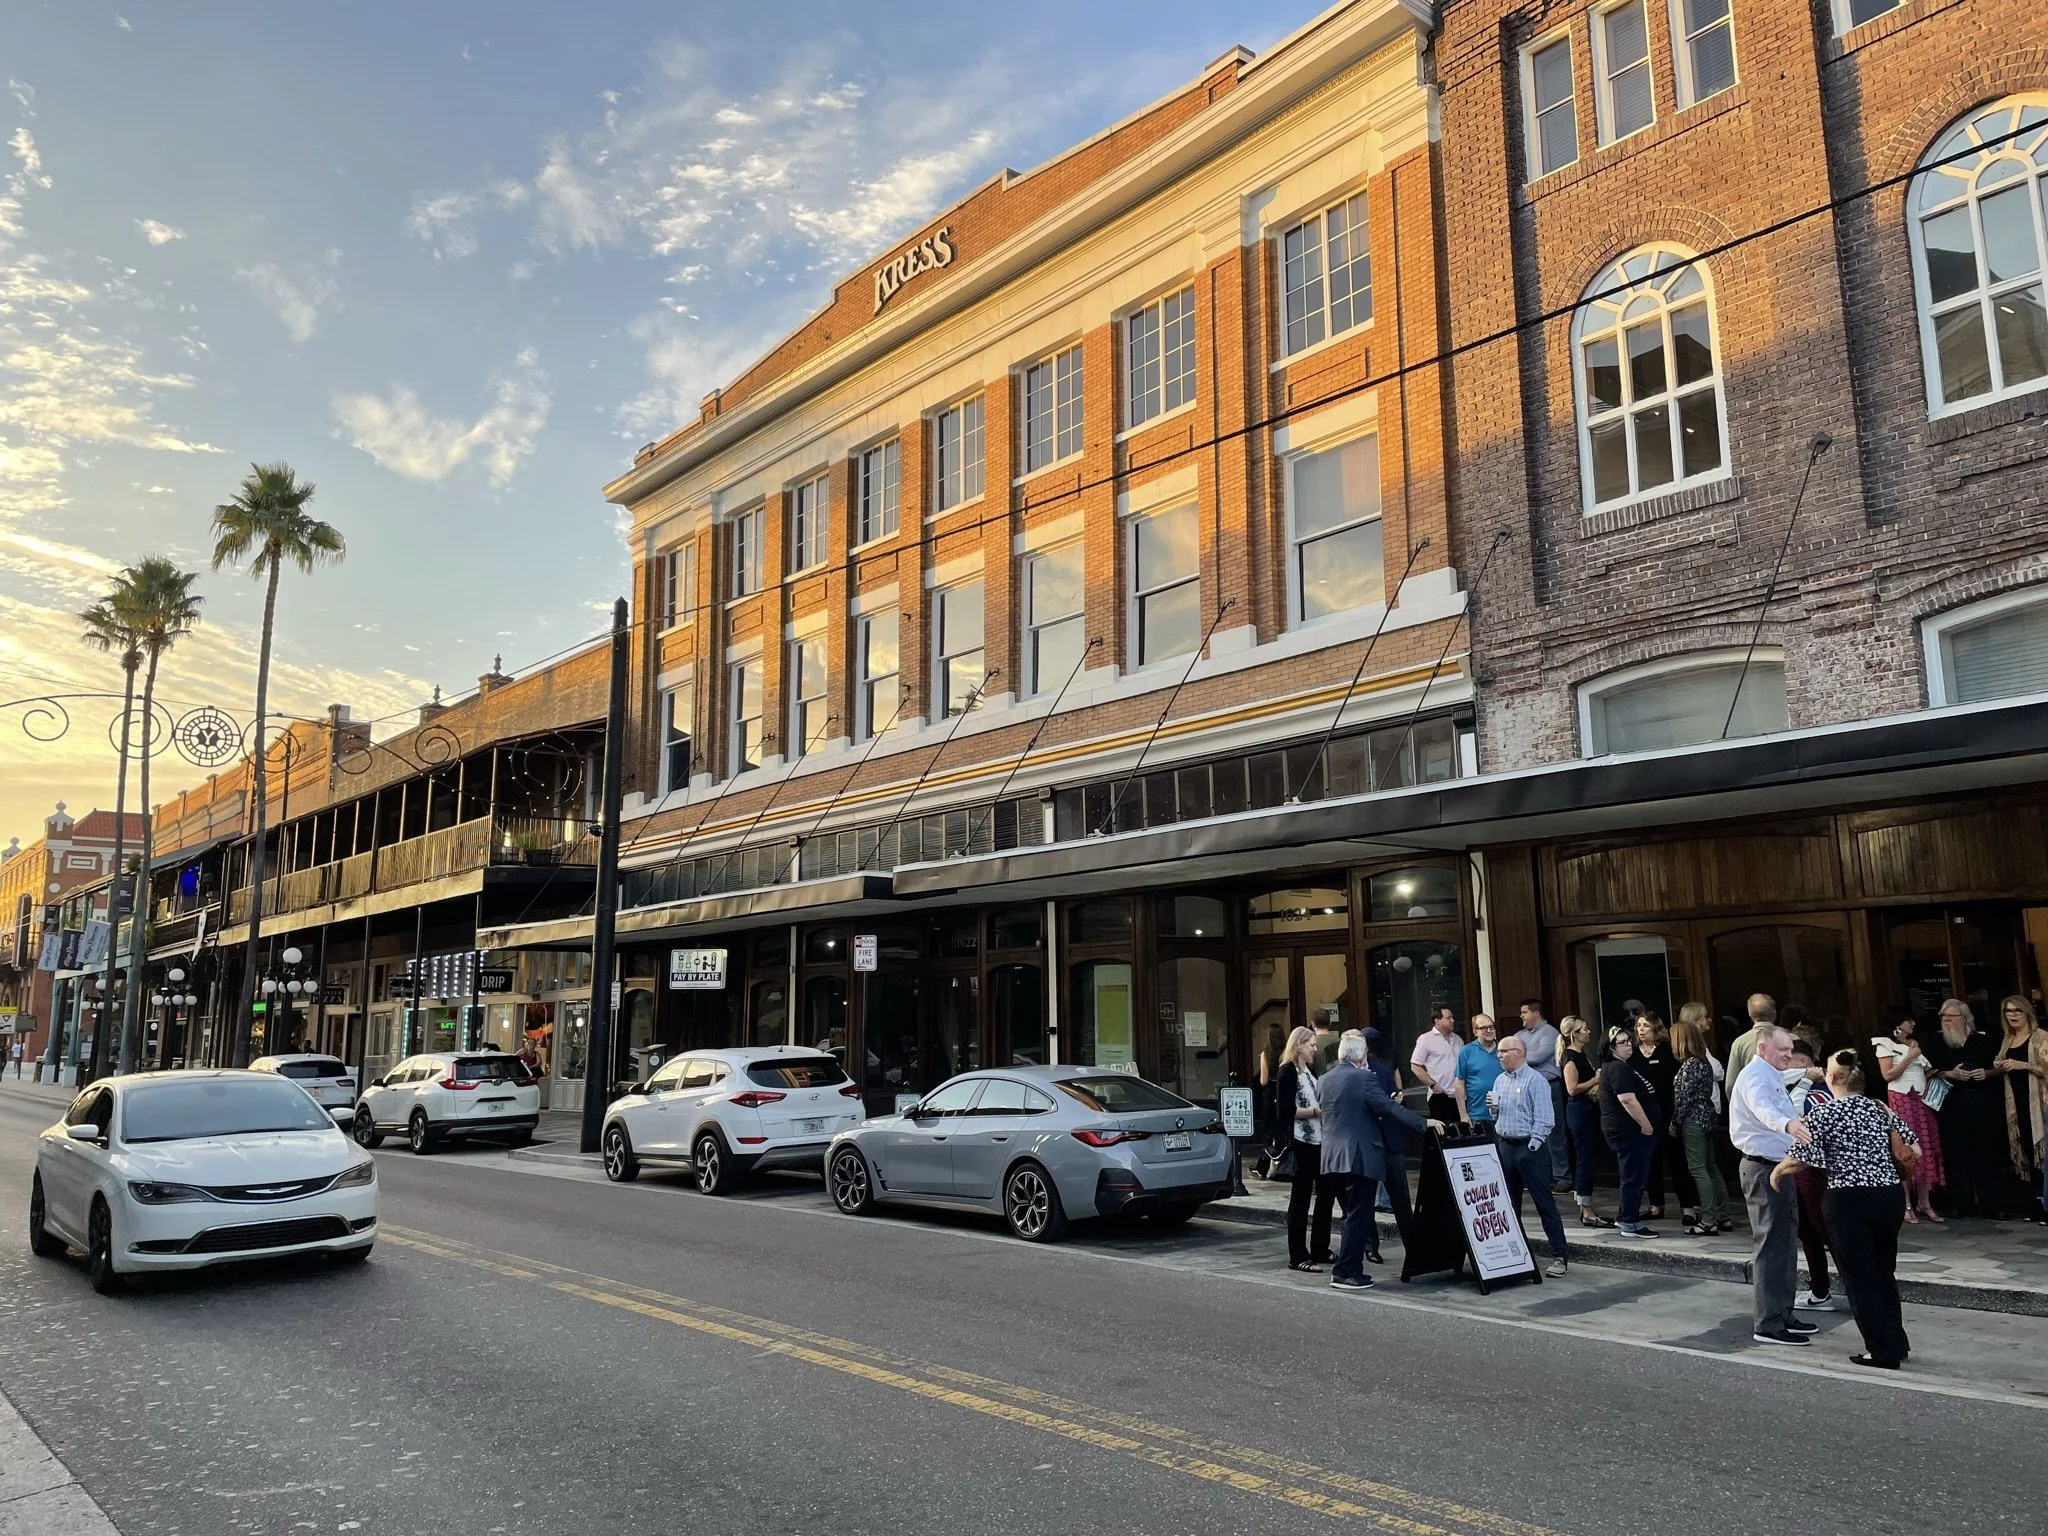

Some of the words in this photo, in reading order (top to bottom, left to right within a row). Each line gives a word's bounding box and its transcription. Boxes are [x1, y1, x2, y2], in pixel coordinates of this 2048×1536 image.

[873, 227, 955, 316] KRESS
[858, 949, 873, 957] FIRE
[481, 975, 505, 988] DRIP
[673, 973, 686, 981] PAY
[687, 973, 697, 981] BY
[698, 973, 720, 981] PLATE
[1463, 1183, 1489, 1206] COME
[1489, 1180, 1500, 1199] IN
[1475, 1199, 1496, 1216] WE'RE
[1472, 1209, 1510, 1242] OPEN
